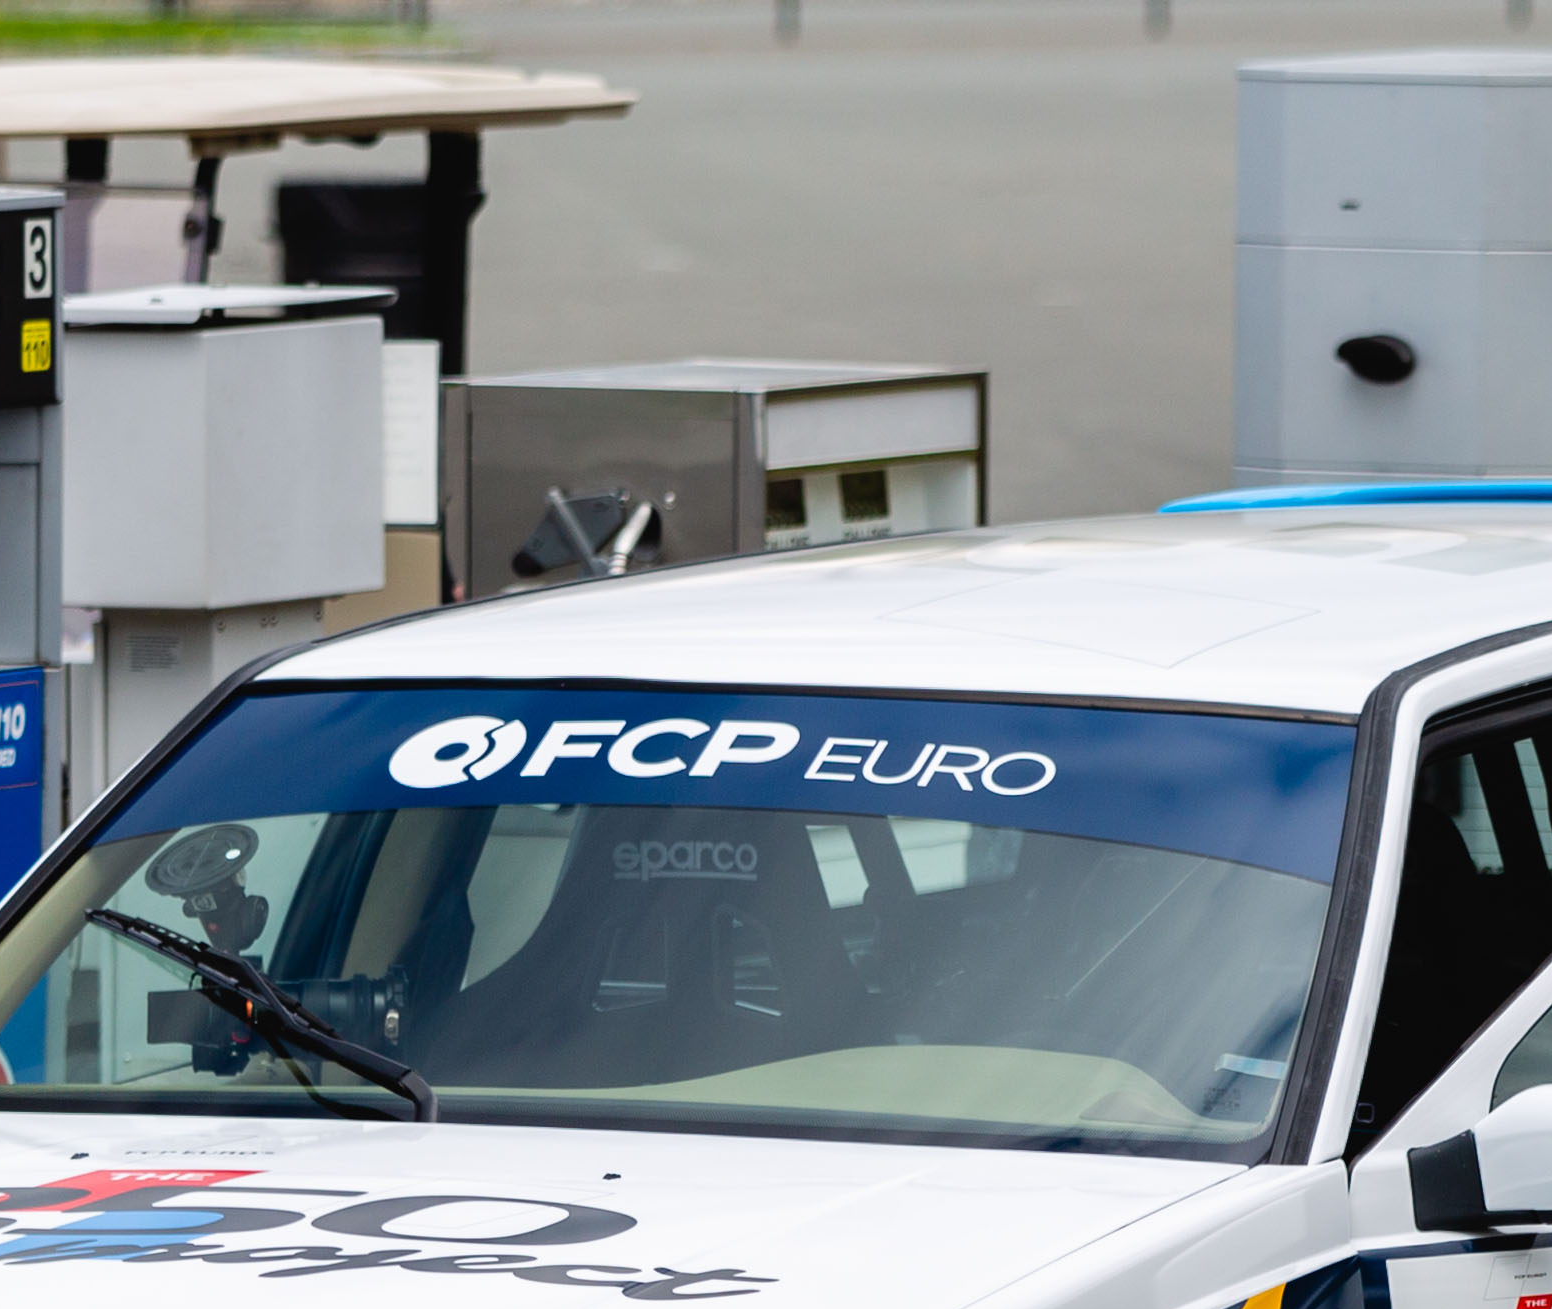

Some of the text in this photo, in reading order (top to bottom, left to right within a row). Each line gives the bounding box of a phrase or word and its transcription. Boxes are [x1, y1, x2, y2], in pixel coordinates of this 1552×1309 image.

[29, 225, 47, 292] 3
[26, 340, 49, 369] 110
[519, 717, 1058, 797] FCP EURO
[613, 841, 758, 882] sparco
[110, 1172, 215, 1182] THE
[1525, 1299, 1548, 1308] THE
